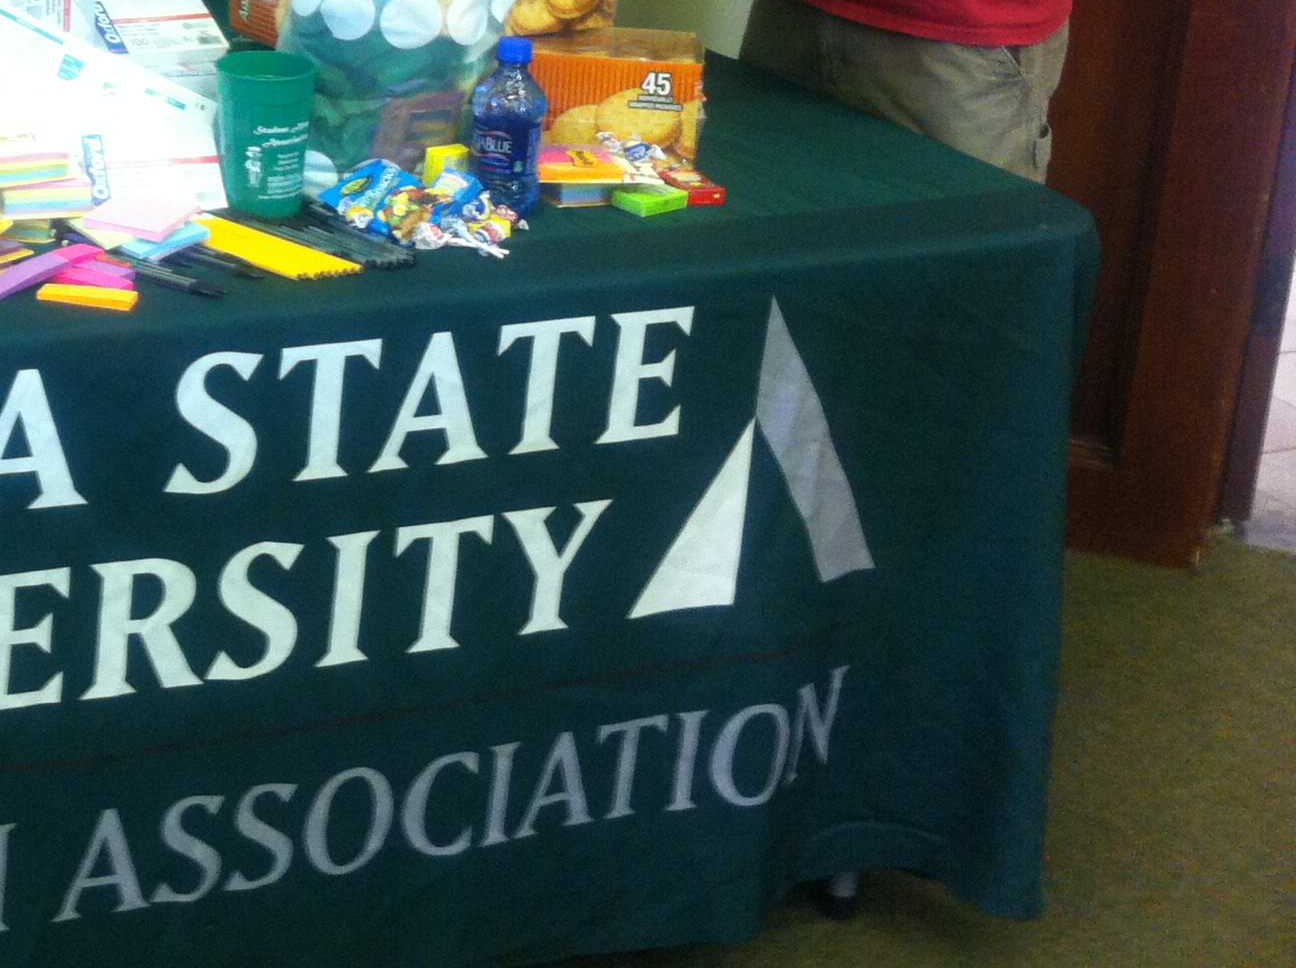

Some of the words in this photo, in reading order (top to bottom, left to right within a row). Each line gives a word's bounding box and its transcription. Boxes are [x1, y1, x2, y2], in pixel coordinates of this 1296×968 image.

[642, 71, 672, 96] 45
[163, 306, 695, 493] STATE
[51, 666, 849, 922] ASSOCIATION
